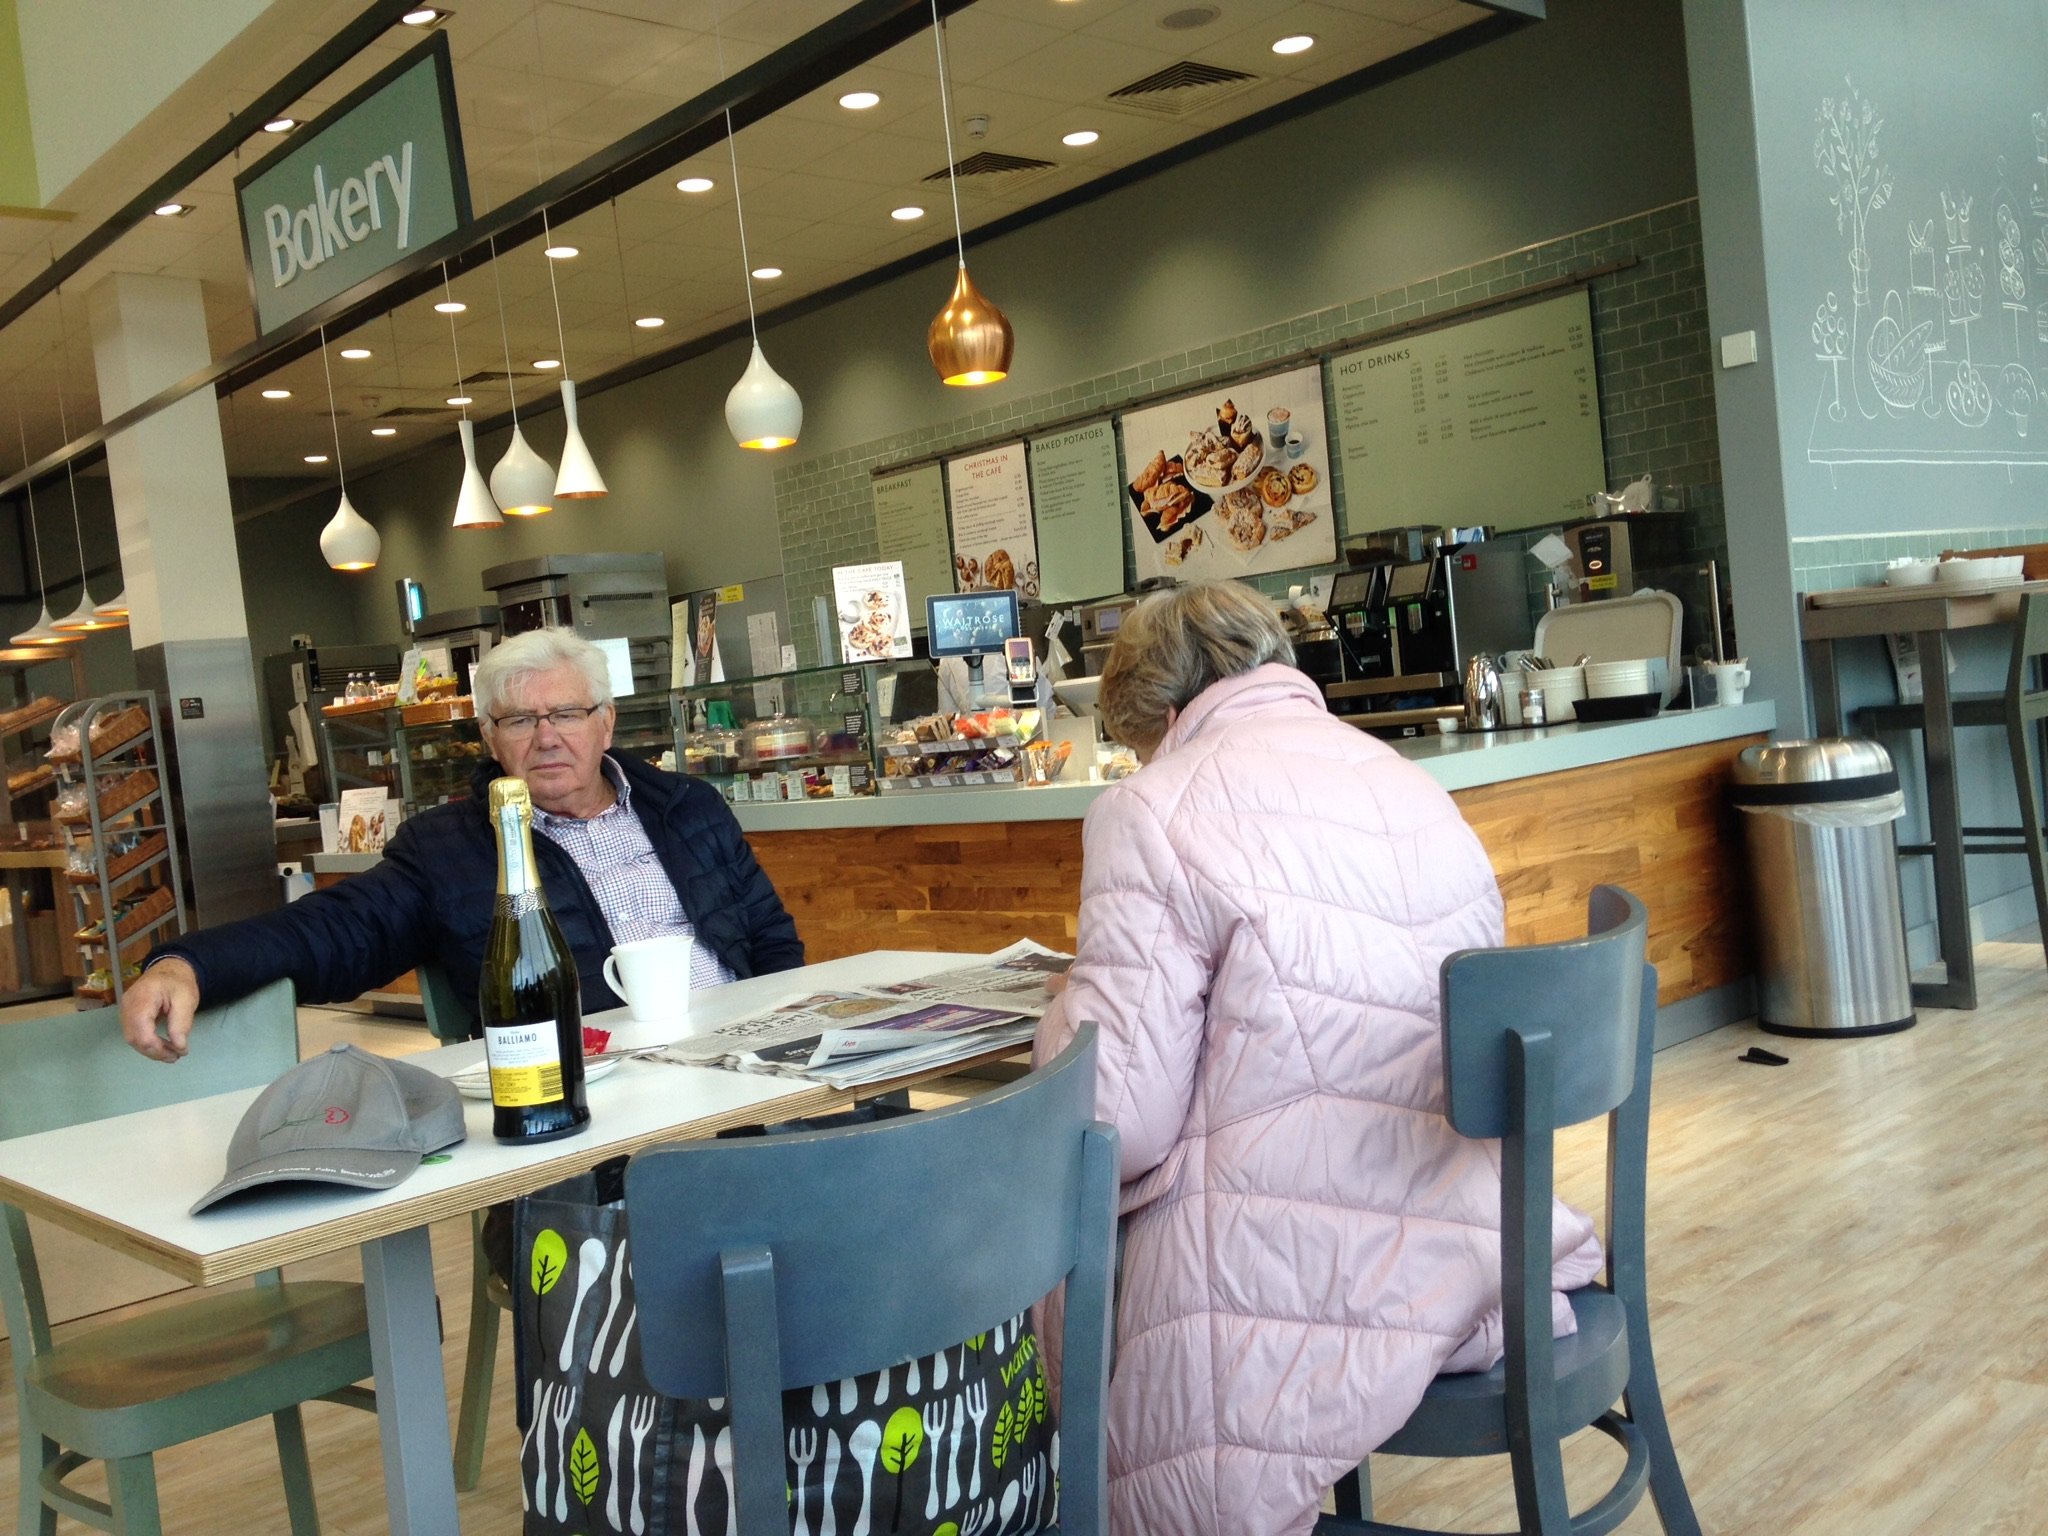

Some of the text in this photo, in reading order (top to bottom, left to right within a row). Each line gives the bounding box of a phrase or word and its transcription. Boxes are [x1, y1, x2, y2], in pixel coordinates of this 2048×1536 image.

[263, 141, 413, 289] Bakery
[1340, 348, 1410, 376] HOT DRINKS
[1035, 427, 1104, 453] BAKED POTATOES
[964, 454, 1008, 471] CHRISTMAS IN
[971, 470, 984, 479] THE
[876, 478, 912, 495] BREAKFAST
[874, 564, 894, 572] TODAY
[942, 614, 1005, 627] WAITROSE
[498, 1032, 537, 1045] BALLIAMO
